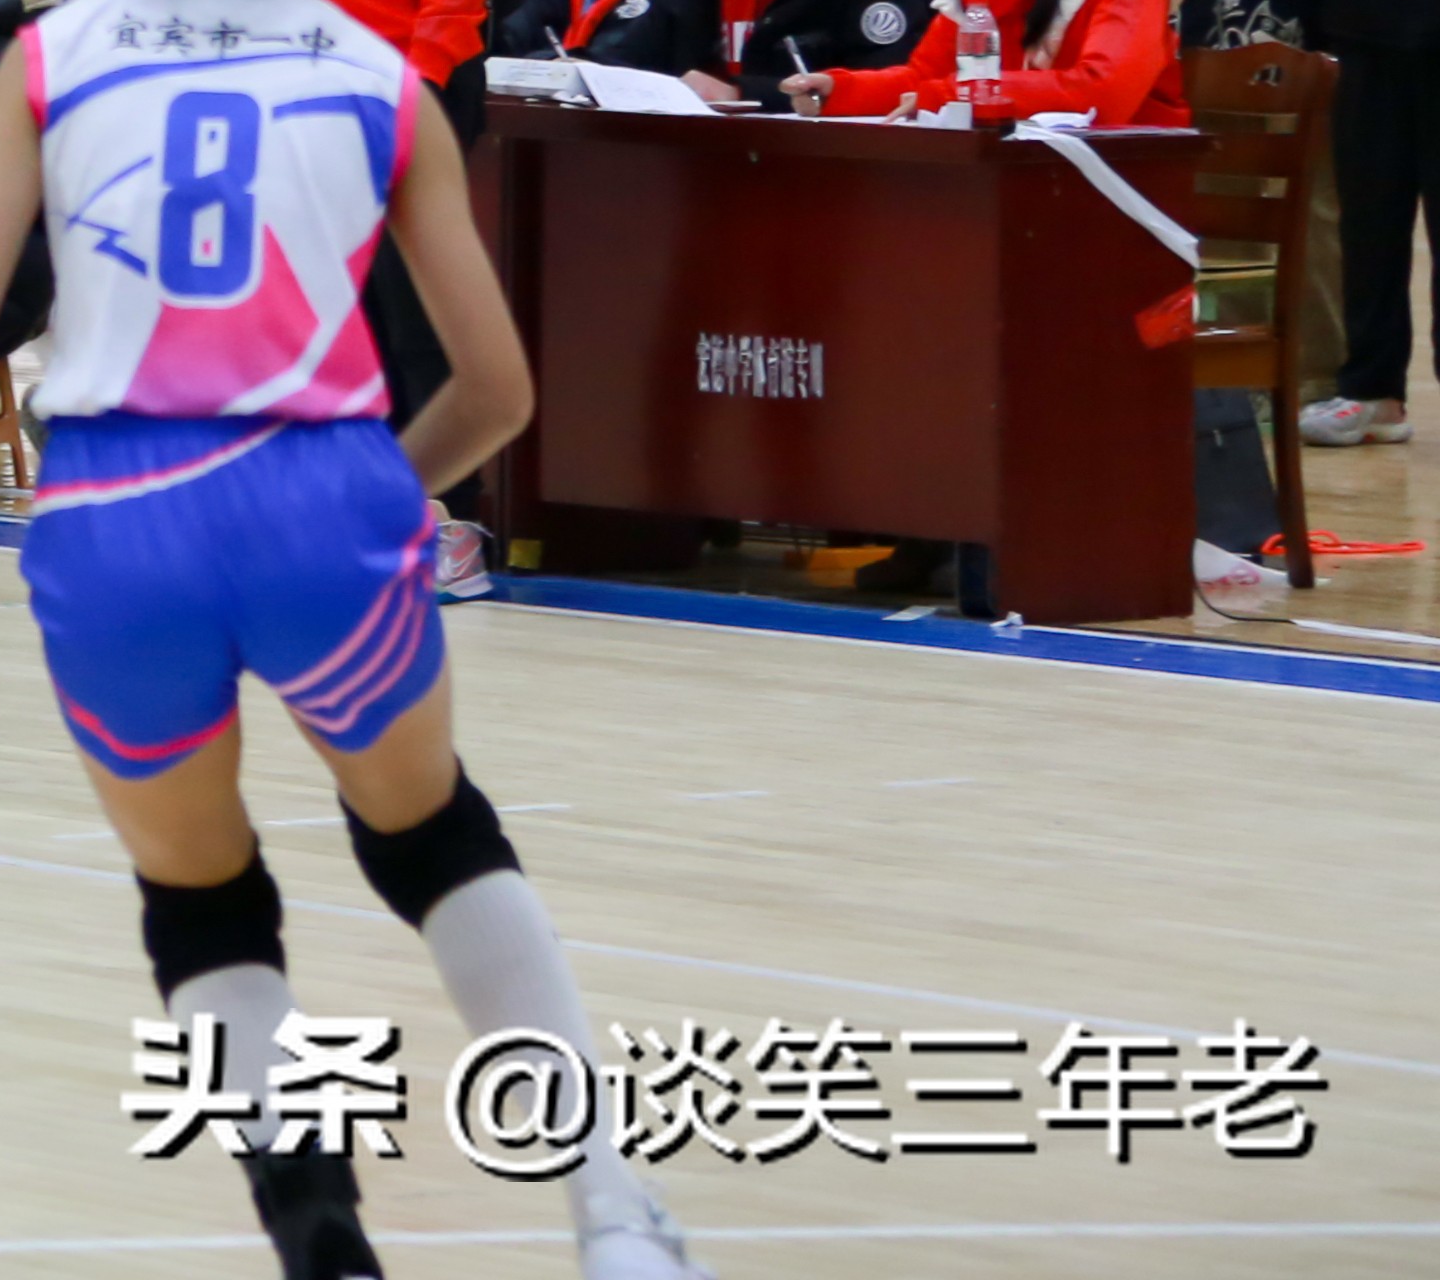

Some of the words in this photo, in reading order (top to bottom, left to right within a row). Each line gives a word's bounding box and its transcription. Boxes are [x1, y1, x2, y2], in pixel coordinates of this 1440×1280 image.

[110, 14, 336, 65] 宜宾市一中
[157, 91, 260, 297] 8
